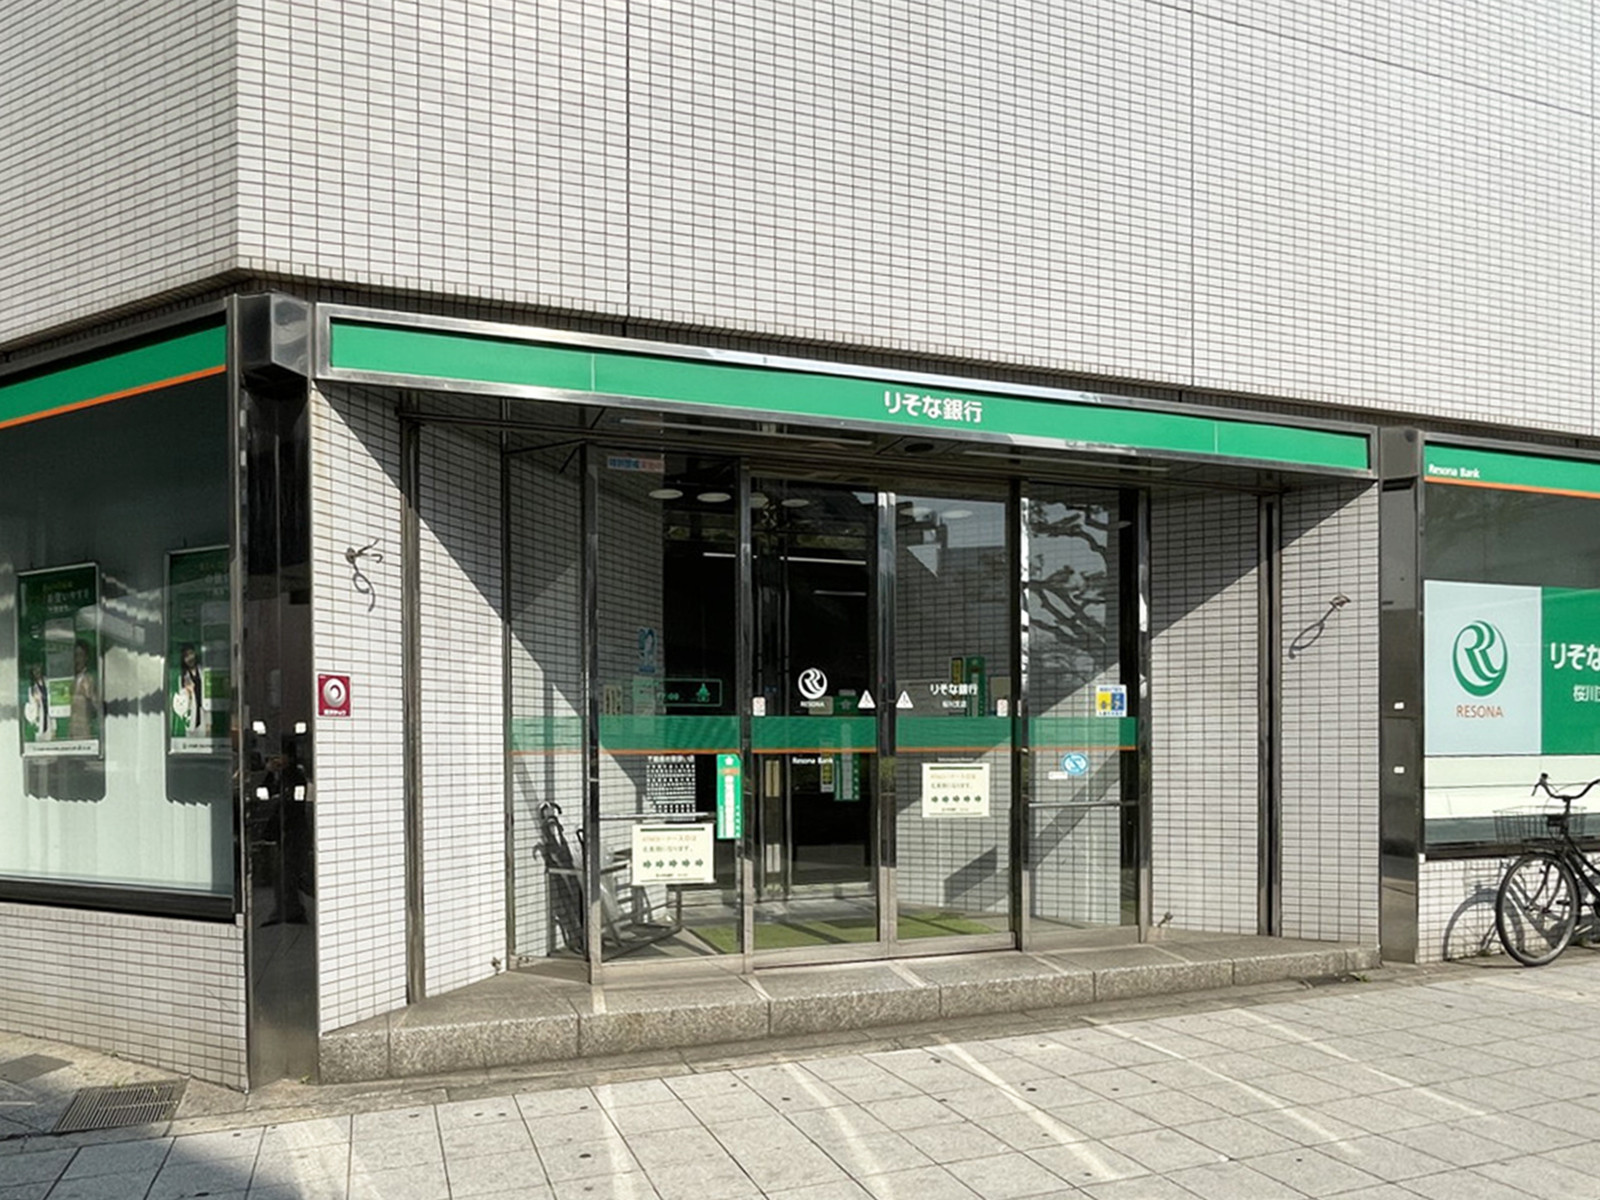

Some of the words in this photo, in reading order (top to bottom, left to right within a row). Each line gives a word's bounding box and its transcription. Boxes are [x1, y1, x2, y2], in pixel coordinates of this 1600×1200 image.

[884, 390, 983, 423] りそな銀行
[1428, 463, 1458, 477] Resona
[1460, 467, 1480, 479] Bank
[1550, 642, 1600, 672] りそな
[929, 683, 978, 696] りそな銀行
[1573, 684, 1600, 703] 桜川
[1455, 704, 1504, 718] RESONA
